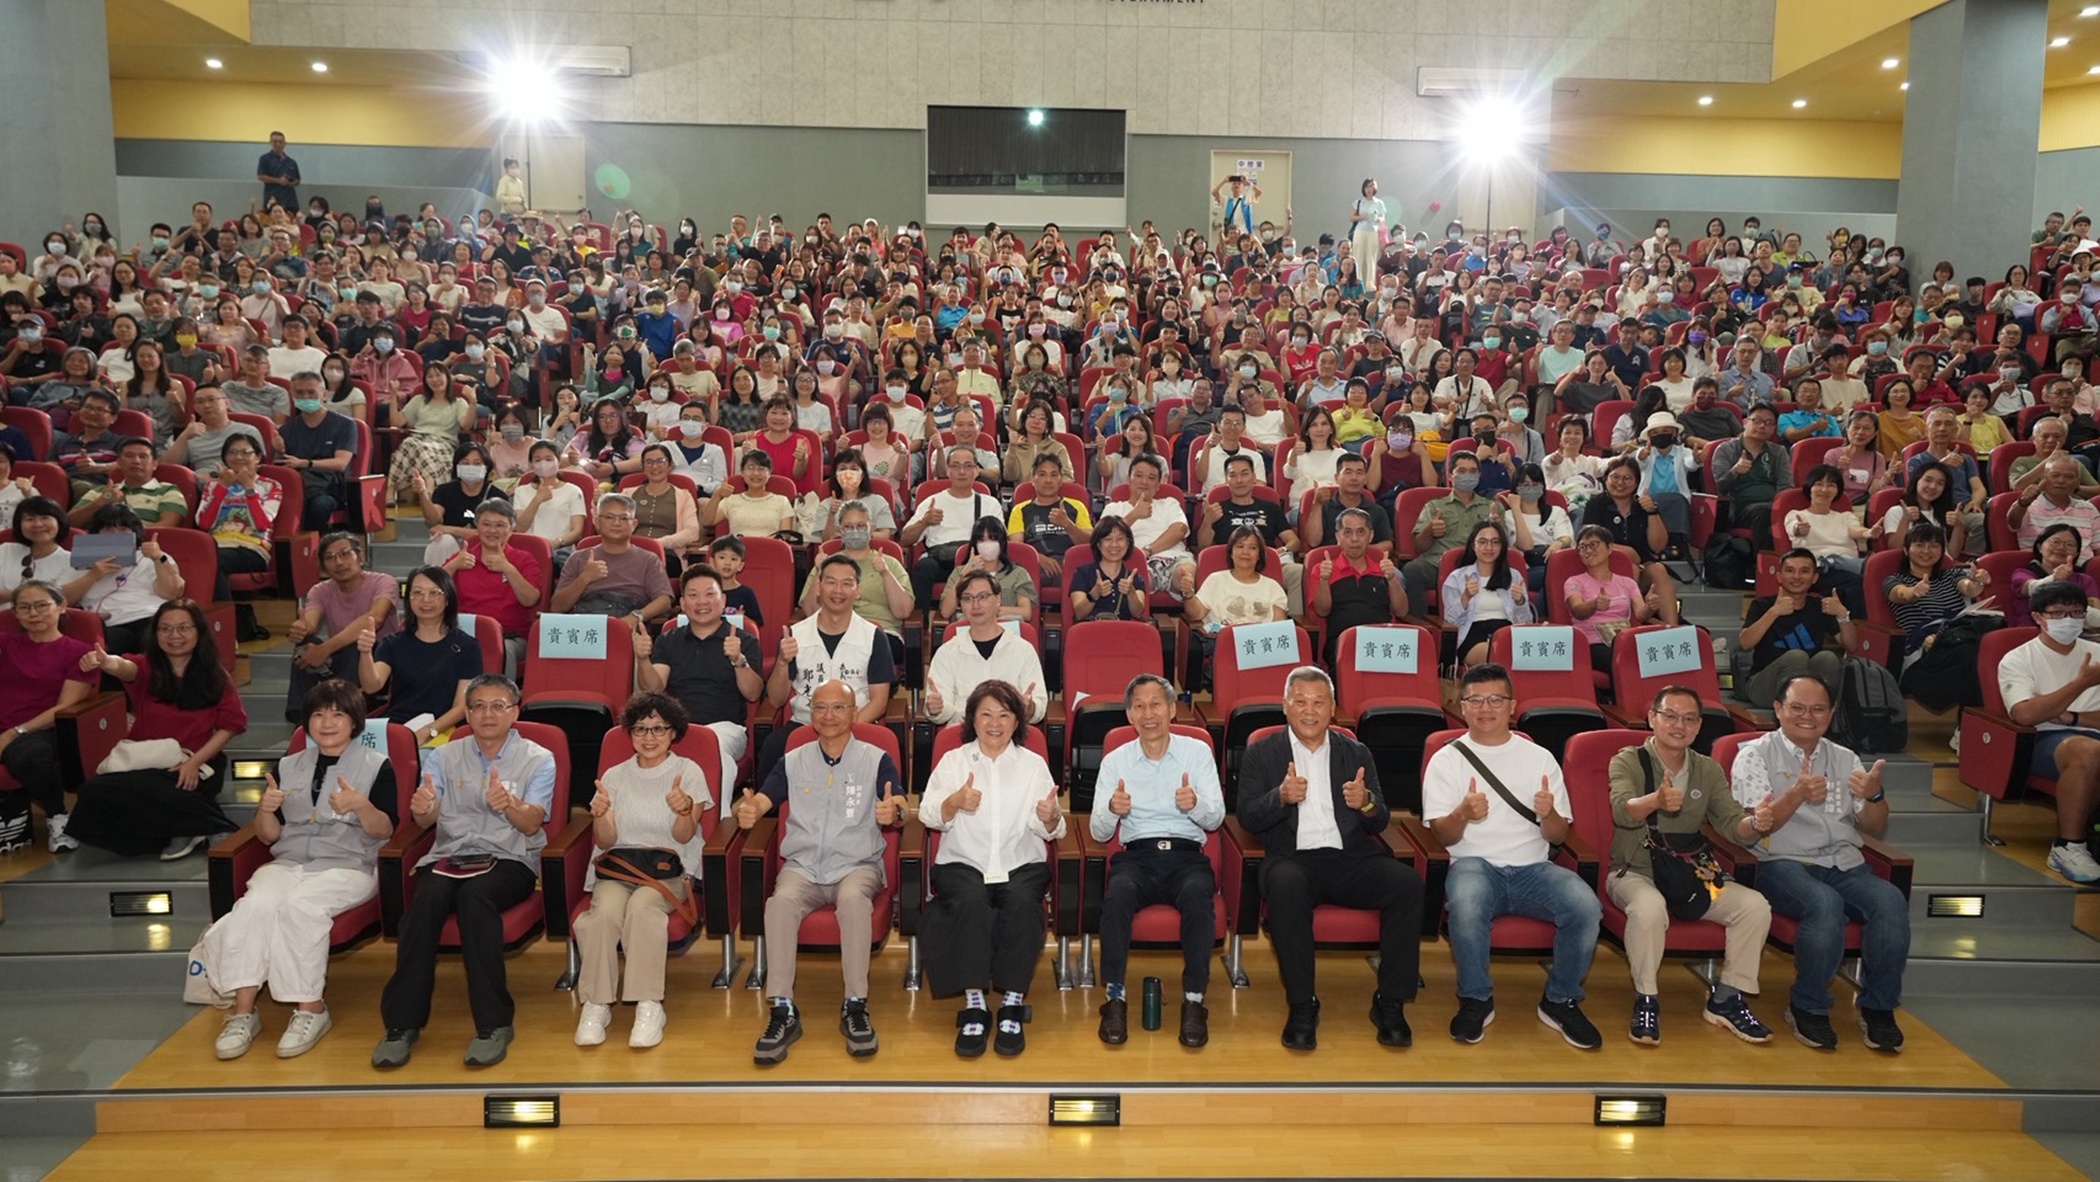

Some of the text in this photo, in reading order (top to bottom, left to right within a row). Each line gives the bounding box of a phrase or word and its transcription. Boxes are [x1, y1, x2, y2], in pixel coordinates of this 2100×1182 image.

[548, 627, 599, 645] 貴賓席
[1243, 635, 1290, 655] 貴賓席
[1364, 641, 1411, 659] 貴賓席
[1519, 640, 1567, 658] 貴賓席
[1646, 641, 1692, 663] 貴賓席
